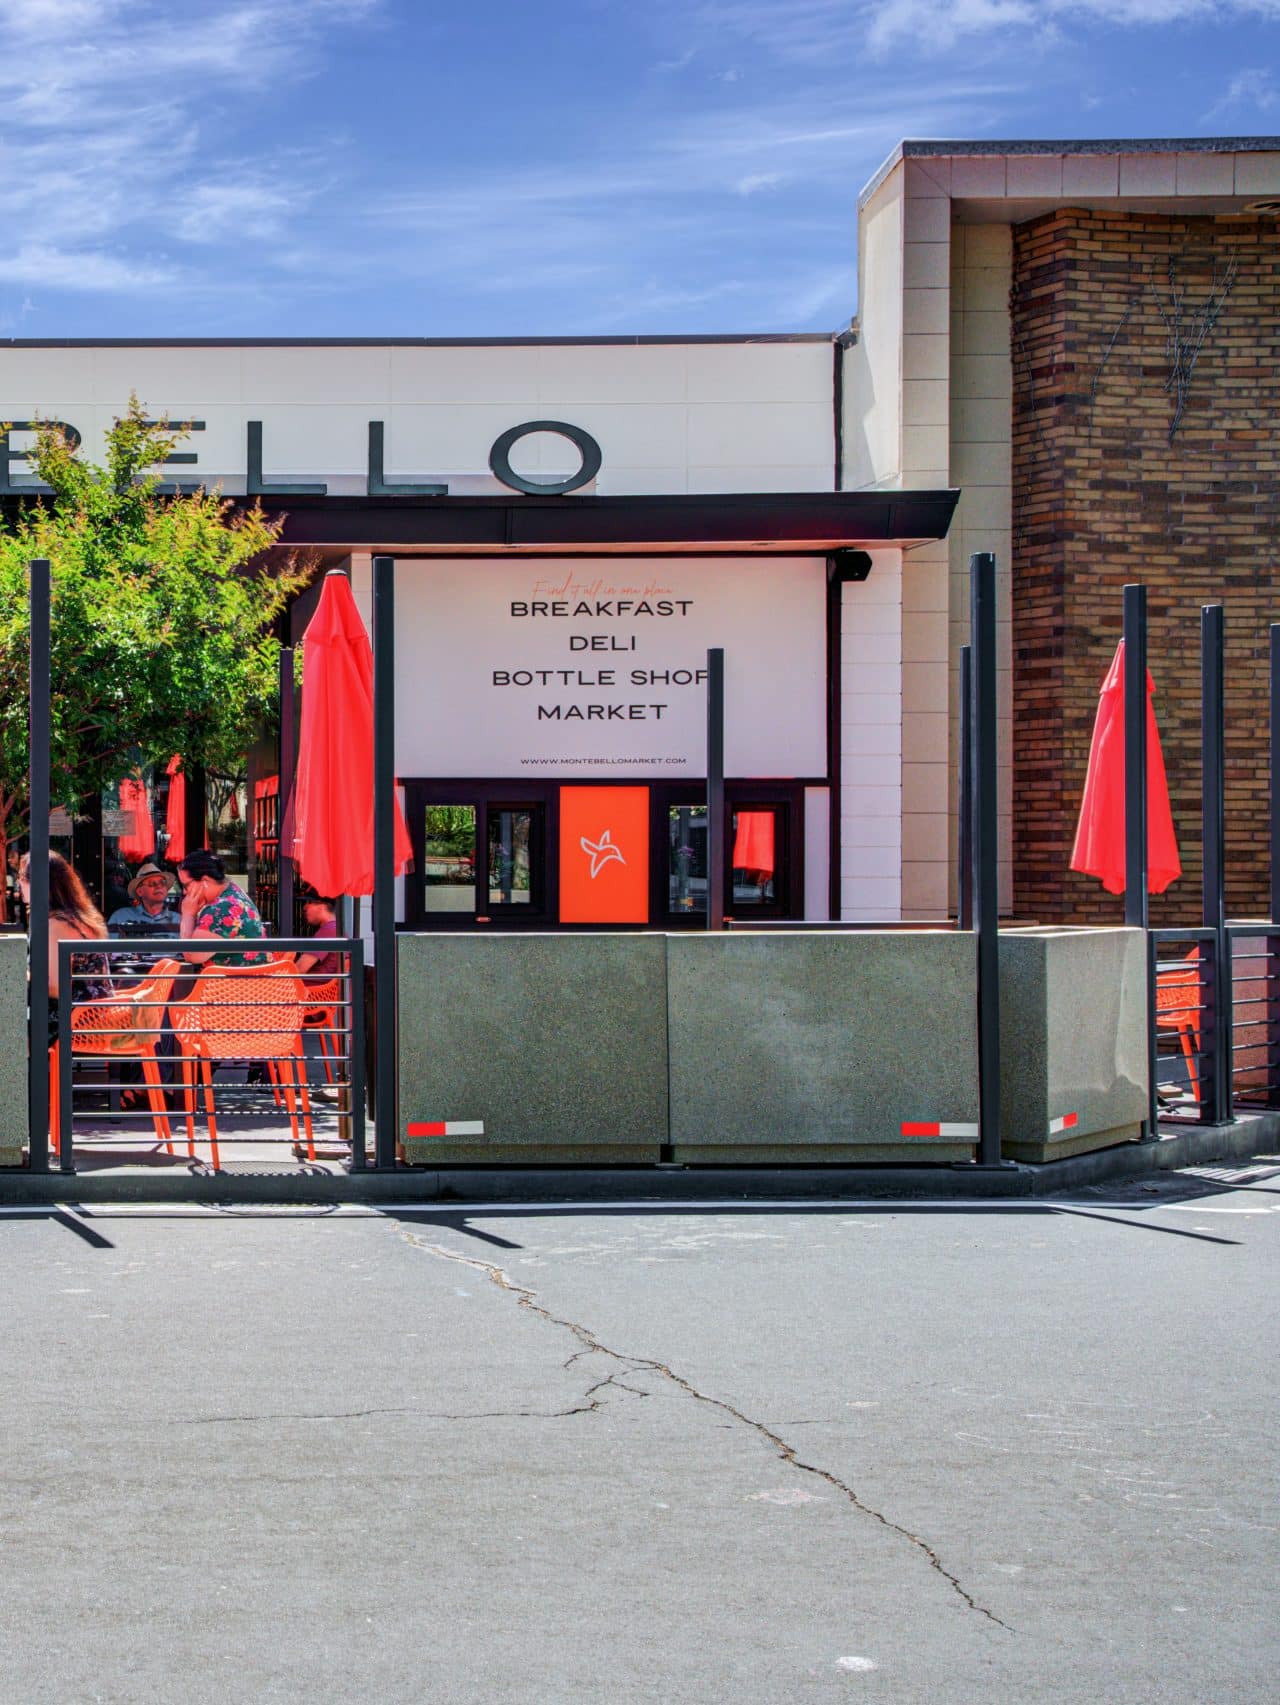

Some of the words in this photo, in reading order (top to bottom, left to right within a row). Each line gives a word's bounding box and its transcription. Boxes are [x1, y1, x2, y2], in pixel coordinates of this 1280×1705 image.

[531, 568, 573, 600] Find
[510, 600, 694, 617] BREAKFAST
[569, 635, 636, 652] DELI
[492, 669, 616, 686] BOTTLE
[537, 704, 669, 721] MARKET
